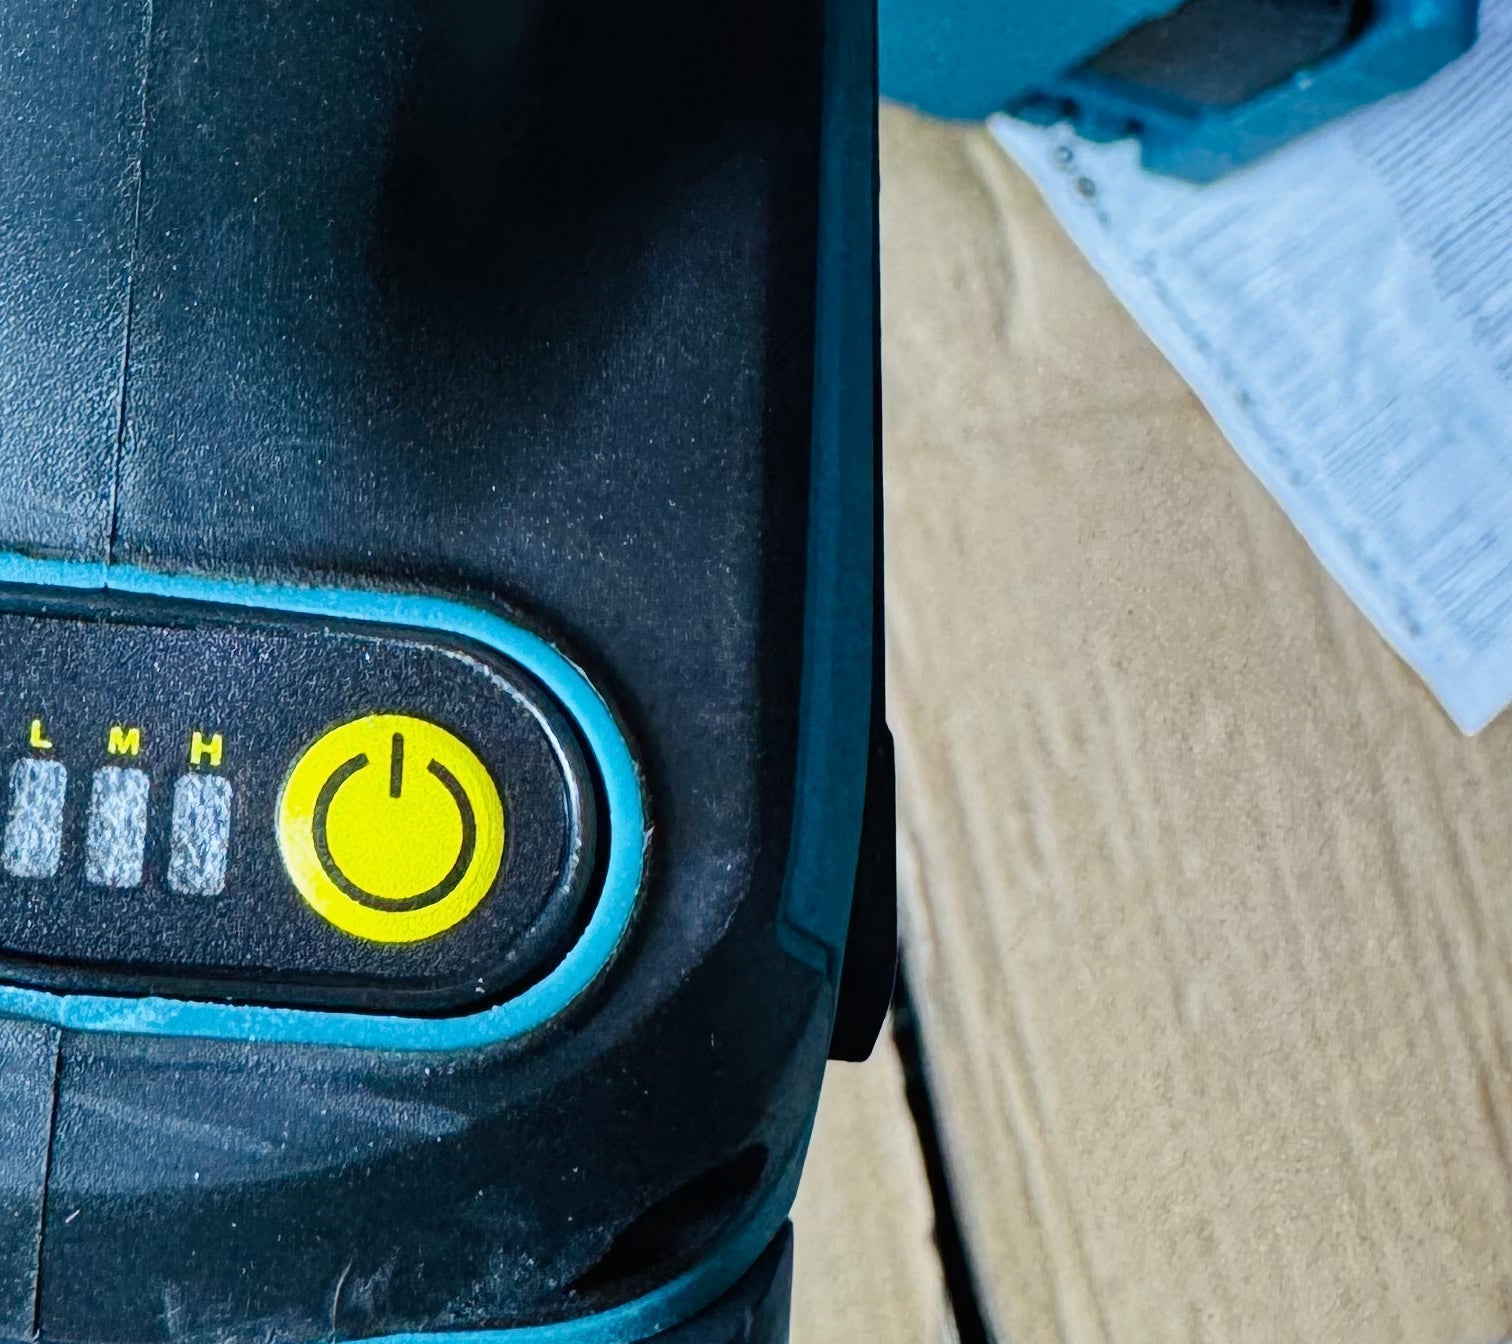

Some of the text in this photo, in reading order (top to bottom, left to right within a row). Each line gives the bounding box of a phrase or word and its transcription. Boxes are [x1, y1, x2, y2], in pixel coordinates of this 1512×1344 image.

[29, 718, 53, 749] L
[107, 725, 141, 757] M
[189, 731, 224, 767] H
